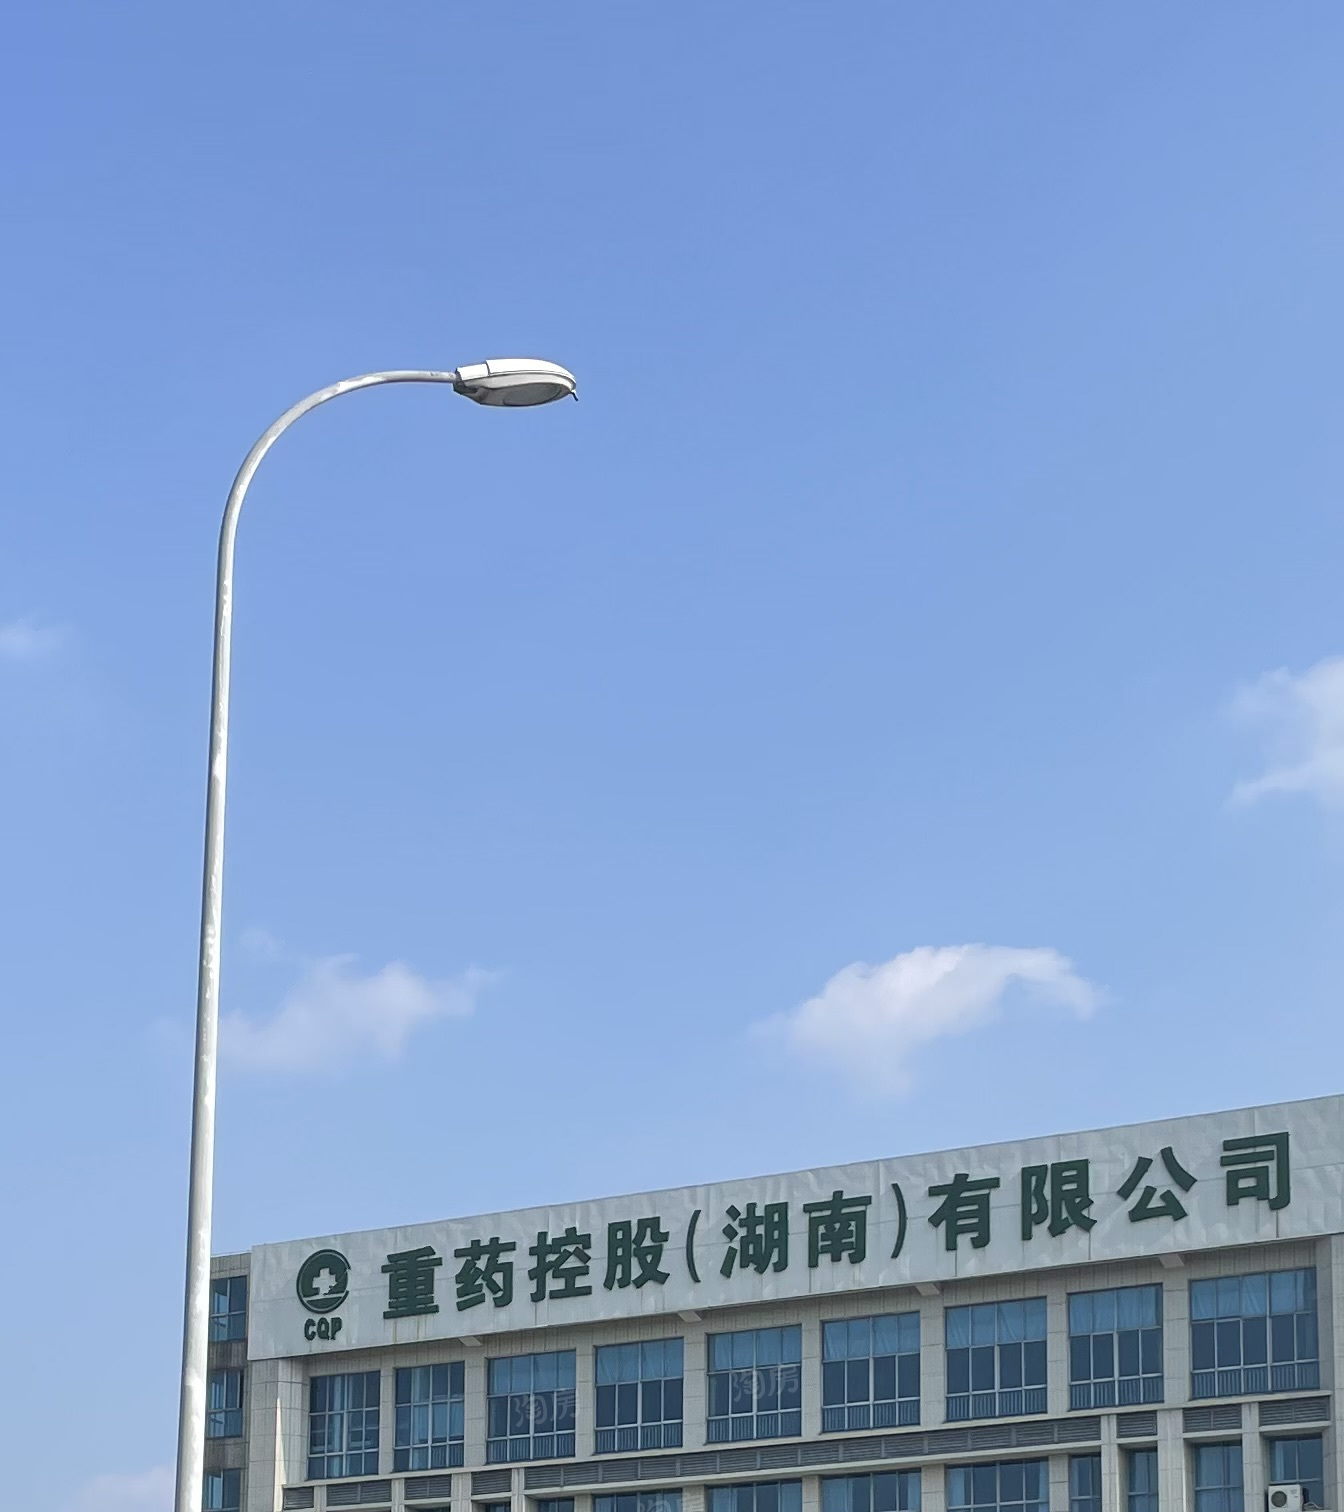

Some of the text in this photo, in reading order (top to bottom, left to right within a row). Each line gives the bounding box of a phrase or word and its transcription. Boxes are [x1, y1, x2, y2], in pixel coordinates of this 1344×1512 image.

[381, 1131, 1291, 1320] 重药控股（湖南）有限公司
[303, 1316, 343, 1341] CQP
